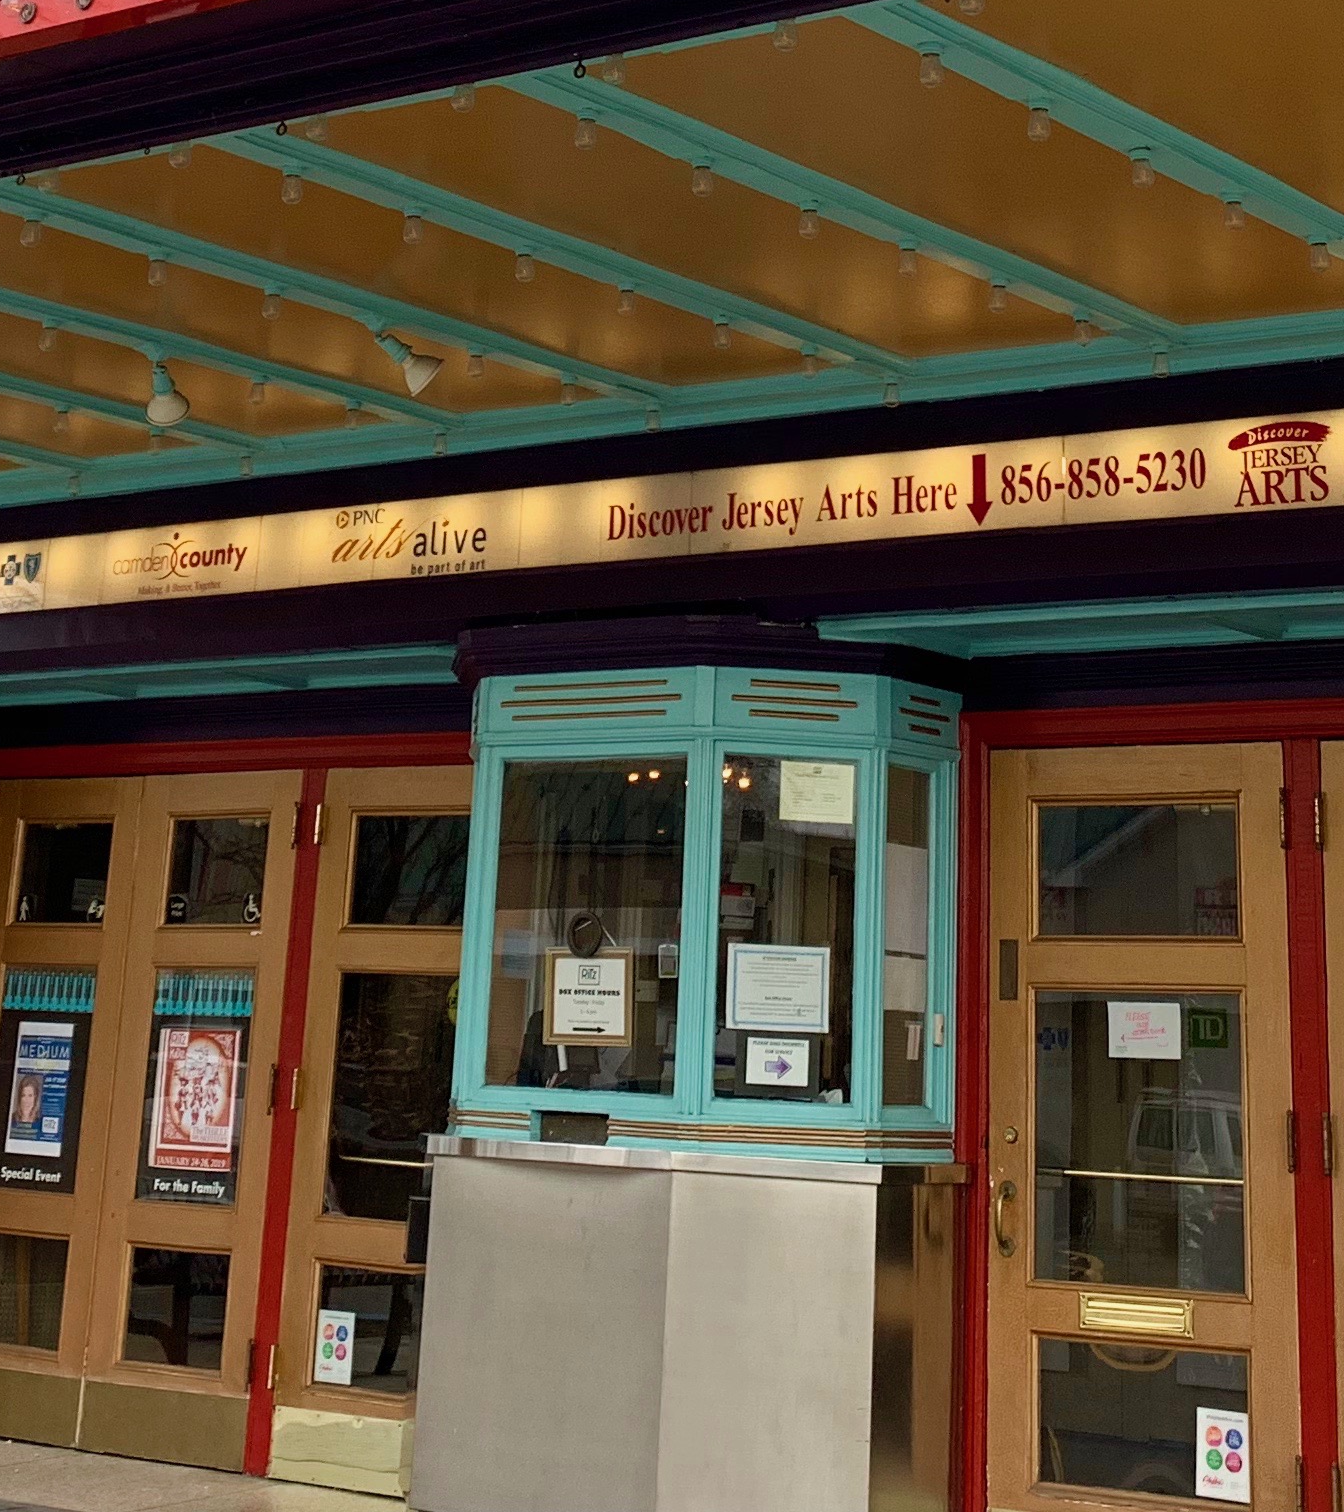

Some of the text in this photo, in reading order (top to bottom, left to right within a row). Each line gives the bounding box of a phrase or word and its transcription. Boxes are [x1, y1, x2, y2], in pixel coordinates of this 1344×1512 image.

[1247, 429, 1310, 446] Discover
[1241, 444, 1324, 472] JERSEY
[1001, 448, 1206, 505] 856-858-5230
[1234, 465, 1331, 507] ARTS
[353, 508, 386, 526] PNC
[607, 475, 958, 541] Discover Jersey Arts Here
[331, 518, 487, 563] arts alive
[113, 543, 248, 575] camden county
[411, 559, 486, 576] be part of art
[1191, 1014, 1224, 1040] TD
[20, 1044, 71, 1058] MEDIUM
[157, 1156, 189, 1166] JANUARY
[1, 1166, 61, 1183] Special Event
[154, 1178, 225, 1198] For the Family
